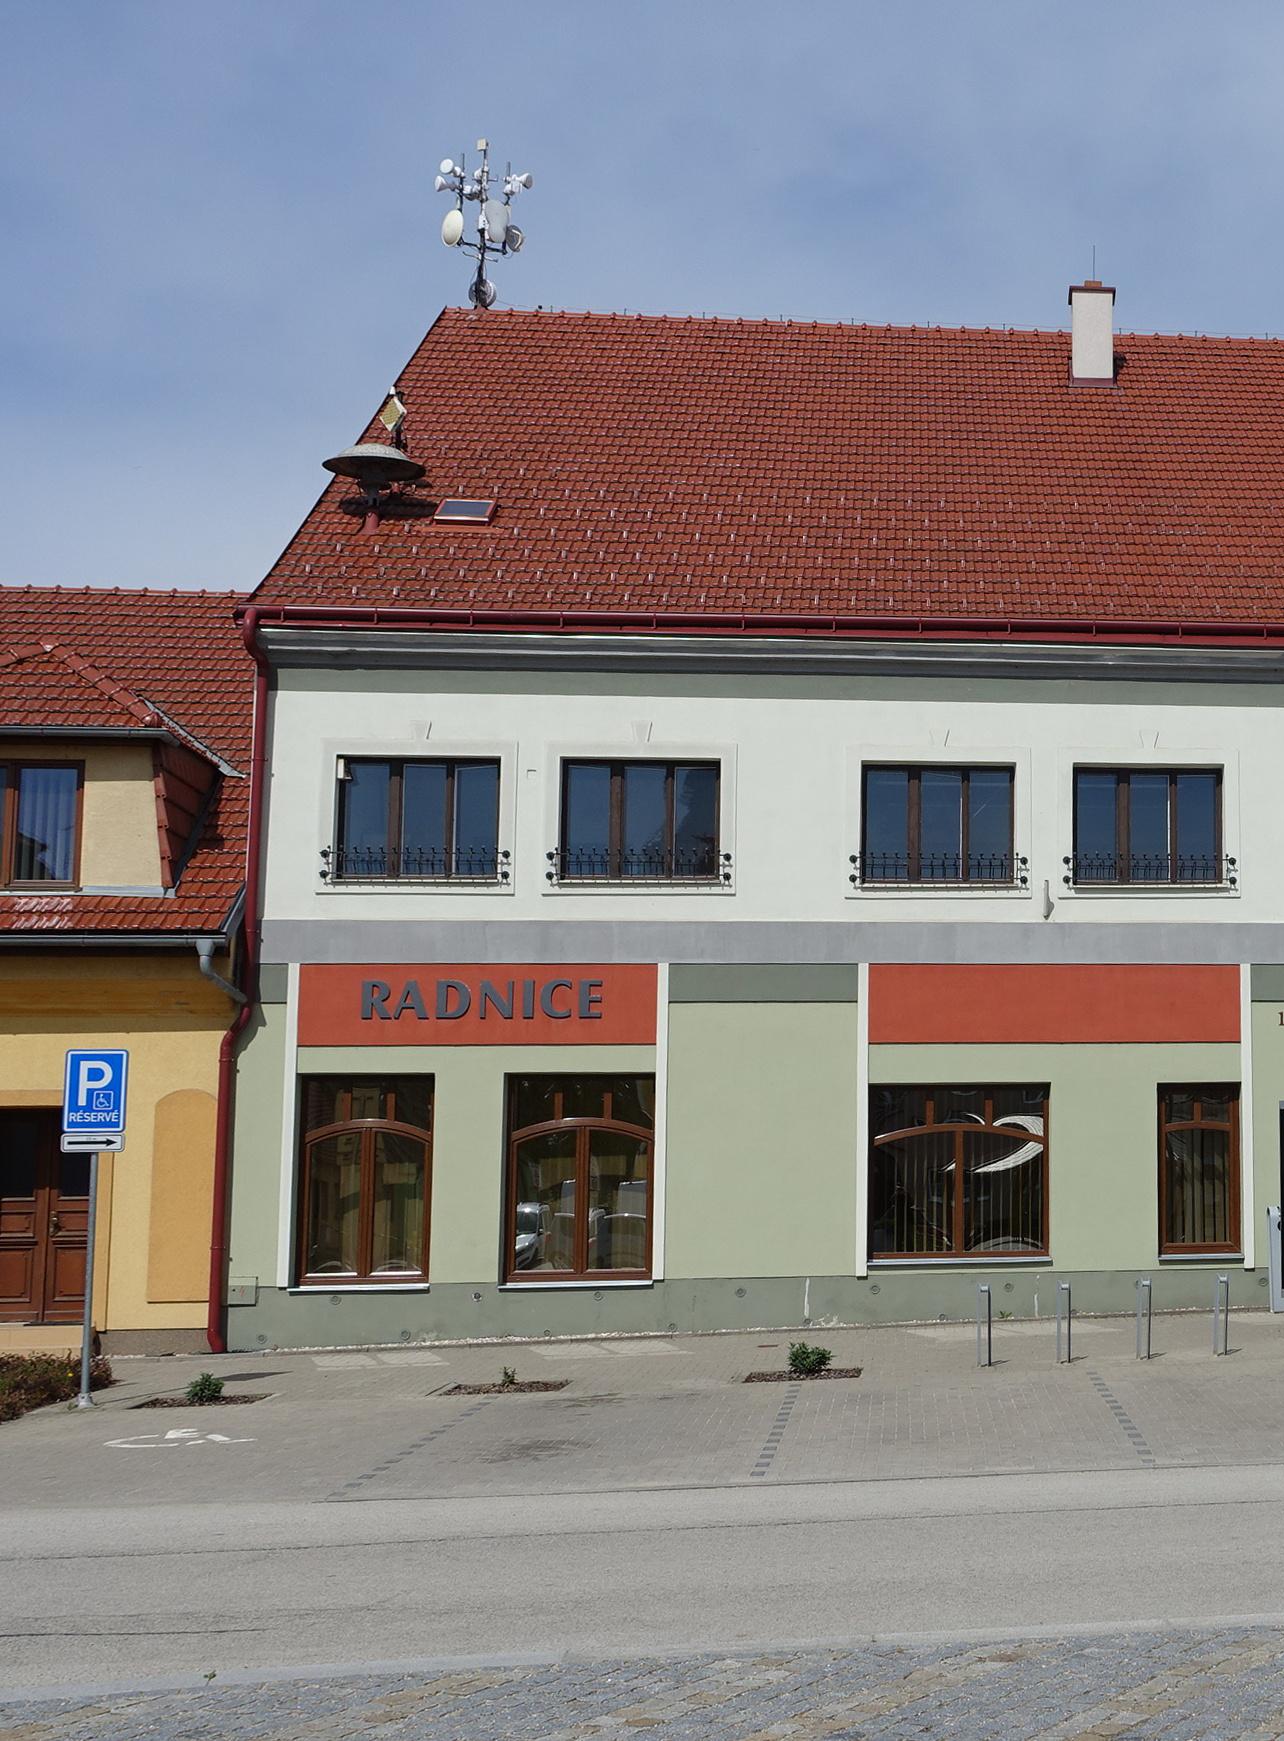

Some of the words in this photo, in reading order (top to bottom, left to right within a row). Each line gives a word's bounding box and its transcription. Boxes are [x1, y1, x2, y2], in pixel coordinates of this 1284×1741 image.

[361, 979, 603, 1020] RADNICE
[77, 1060, 113, 1107] P
[68, 1110, 120, 1122] RÉSERVÉ
